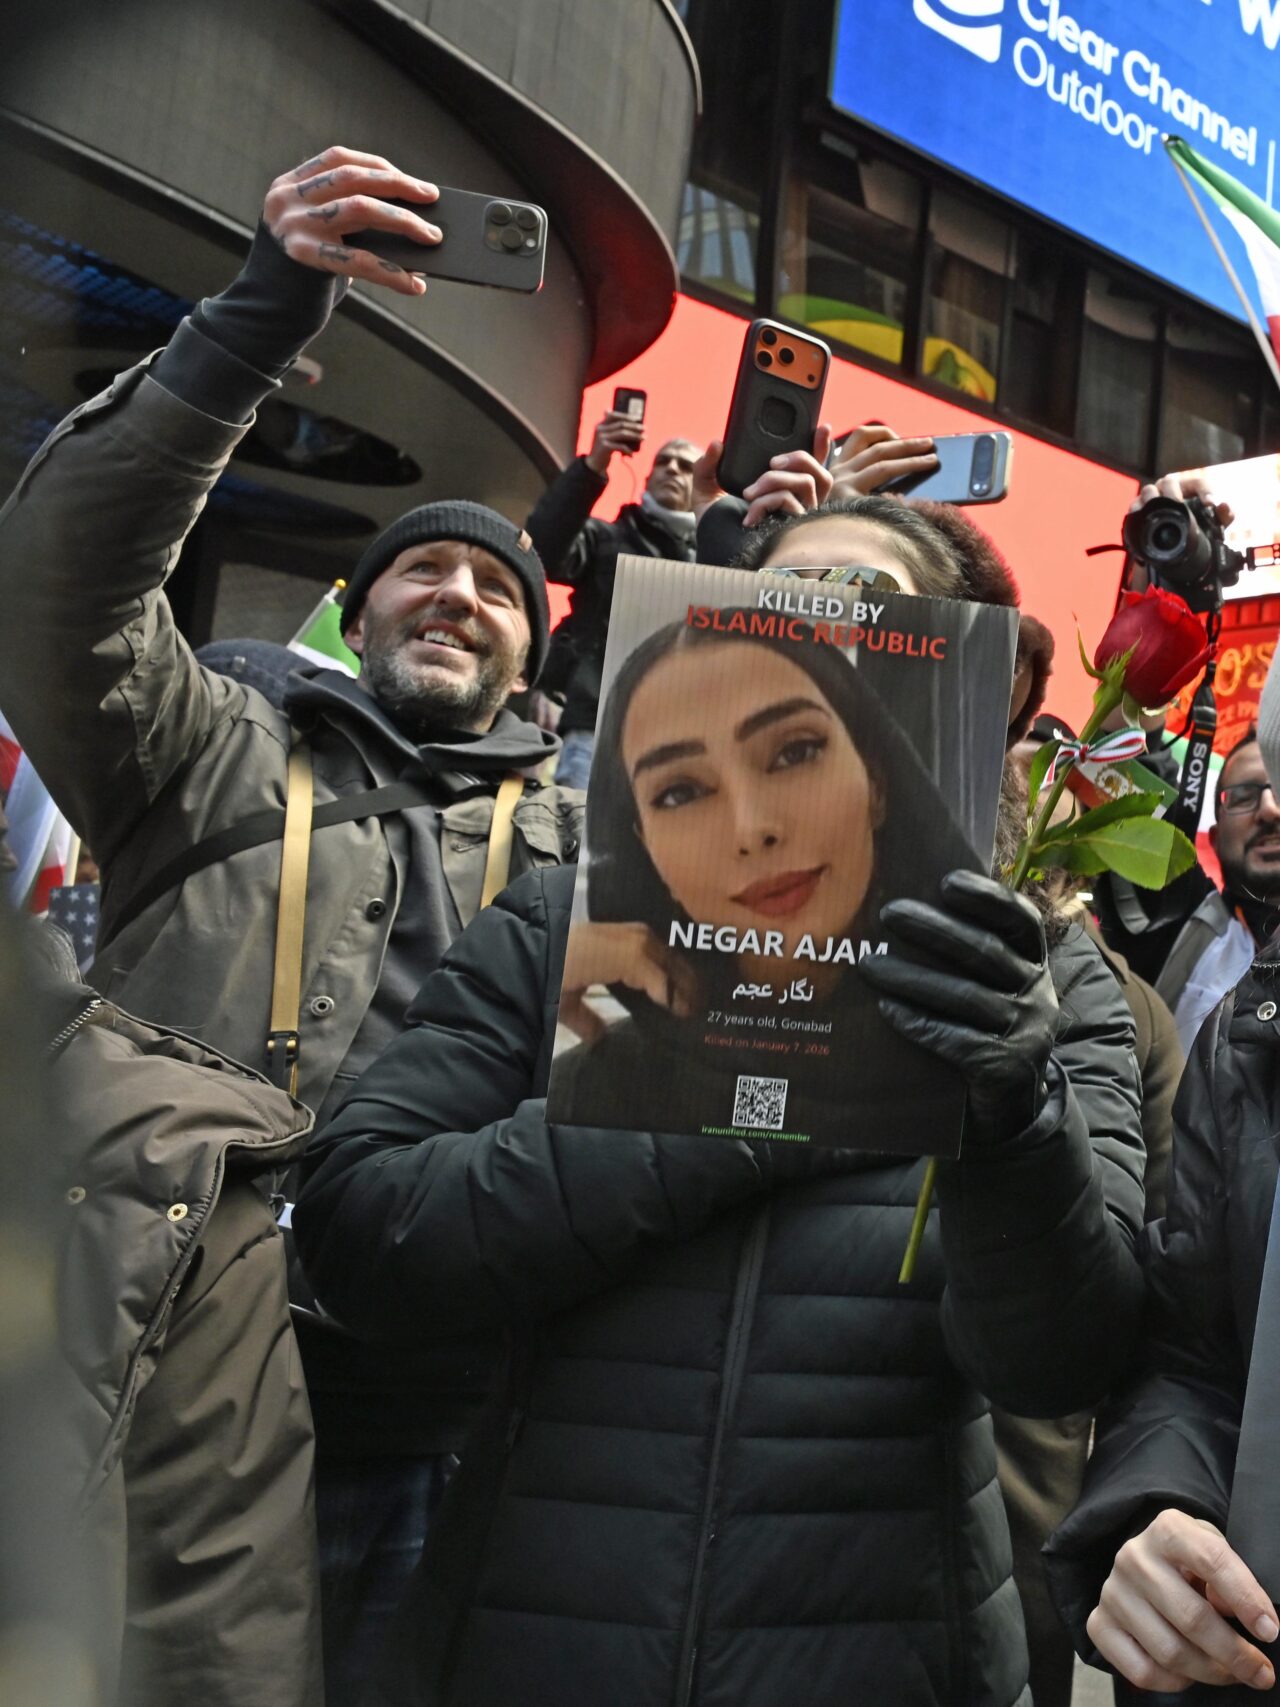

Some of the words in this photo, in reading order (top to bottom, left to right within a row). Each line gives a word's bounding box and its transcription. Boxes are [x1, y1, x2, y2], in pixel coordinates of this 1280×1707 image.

[1013, 37, 1158, 155] Outdoor
[1018, 0, 1120, 76] Clear
[1123, 50, 1257, 166] Channel
[757, 588, 844, 619] KILLED
[852, 601, 885, 625] BY
[686, 604, 804, 641] ISLAMIC
[813, 622, 948, 660] REPUBLIC
[1183, 742, 1207, 813] SONY
[668, 920, 784, 958] NEGAR
[793, 934, 889, 965] AJAM
[732, 983, 773, 1000] عجم
[778, 977, 814, 1004] نگار
[707, 1010, 722, 1023] 27
[724, 1014, 754, 1027] years
[757, 1016, 778, 1030] old,
[781, 1018, 832, 1034] Gonabad
[704, 1034, 733, 1047] Killed
[735, 1039, 749, 1048] on
[752, 1038, 791, 1055] January
